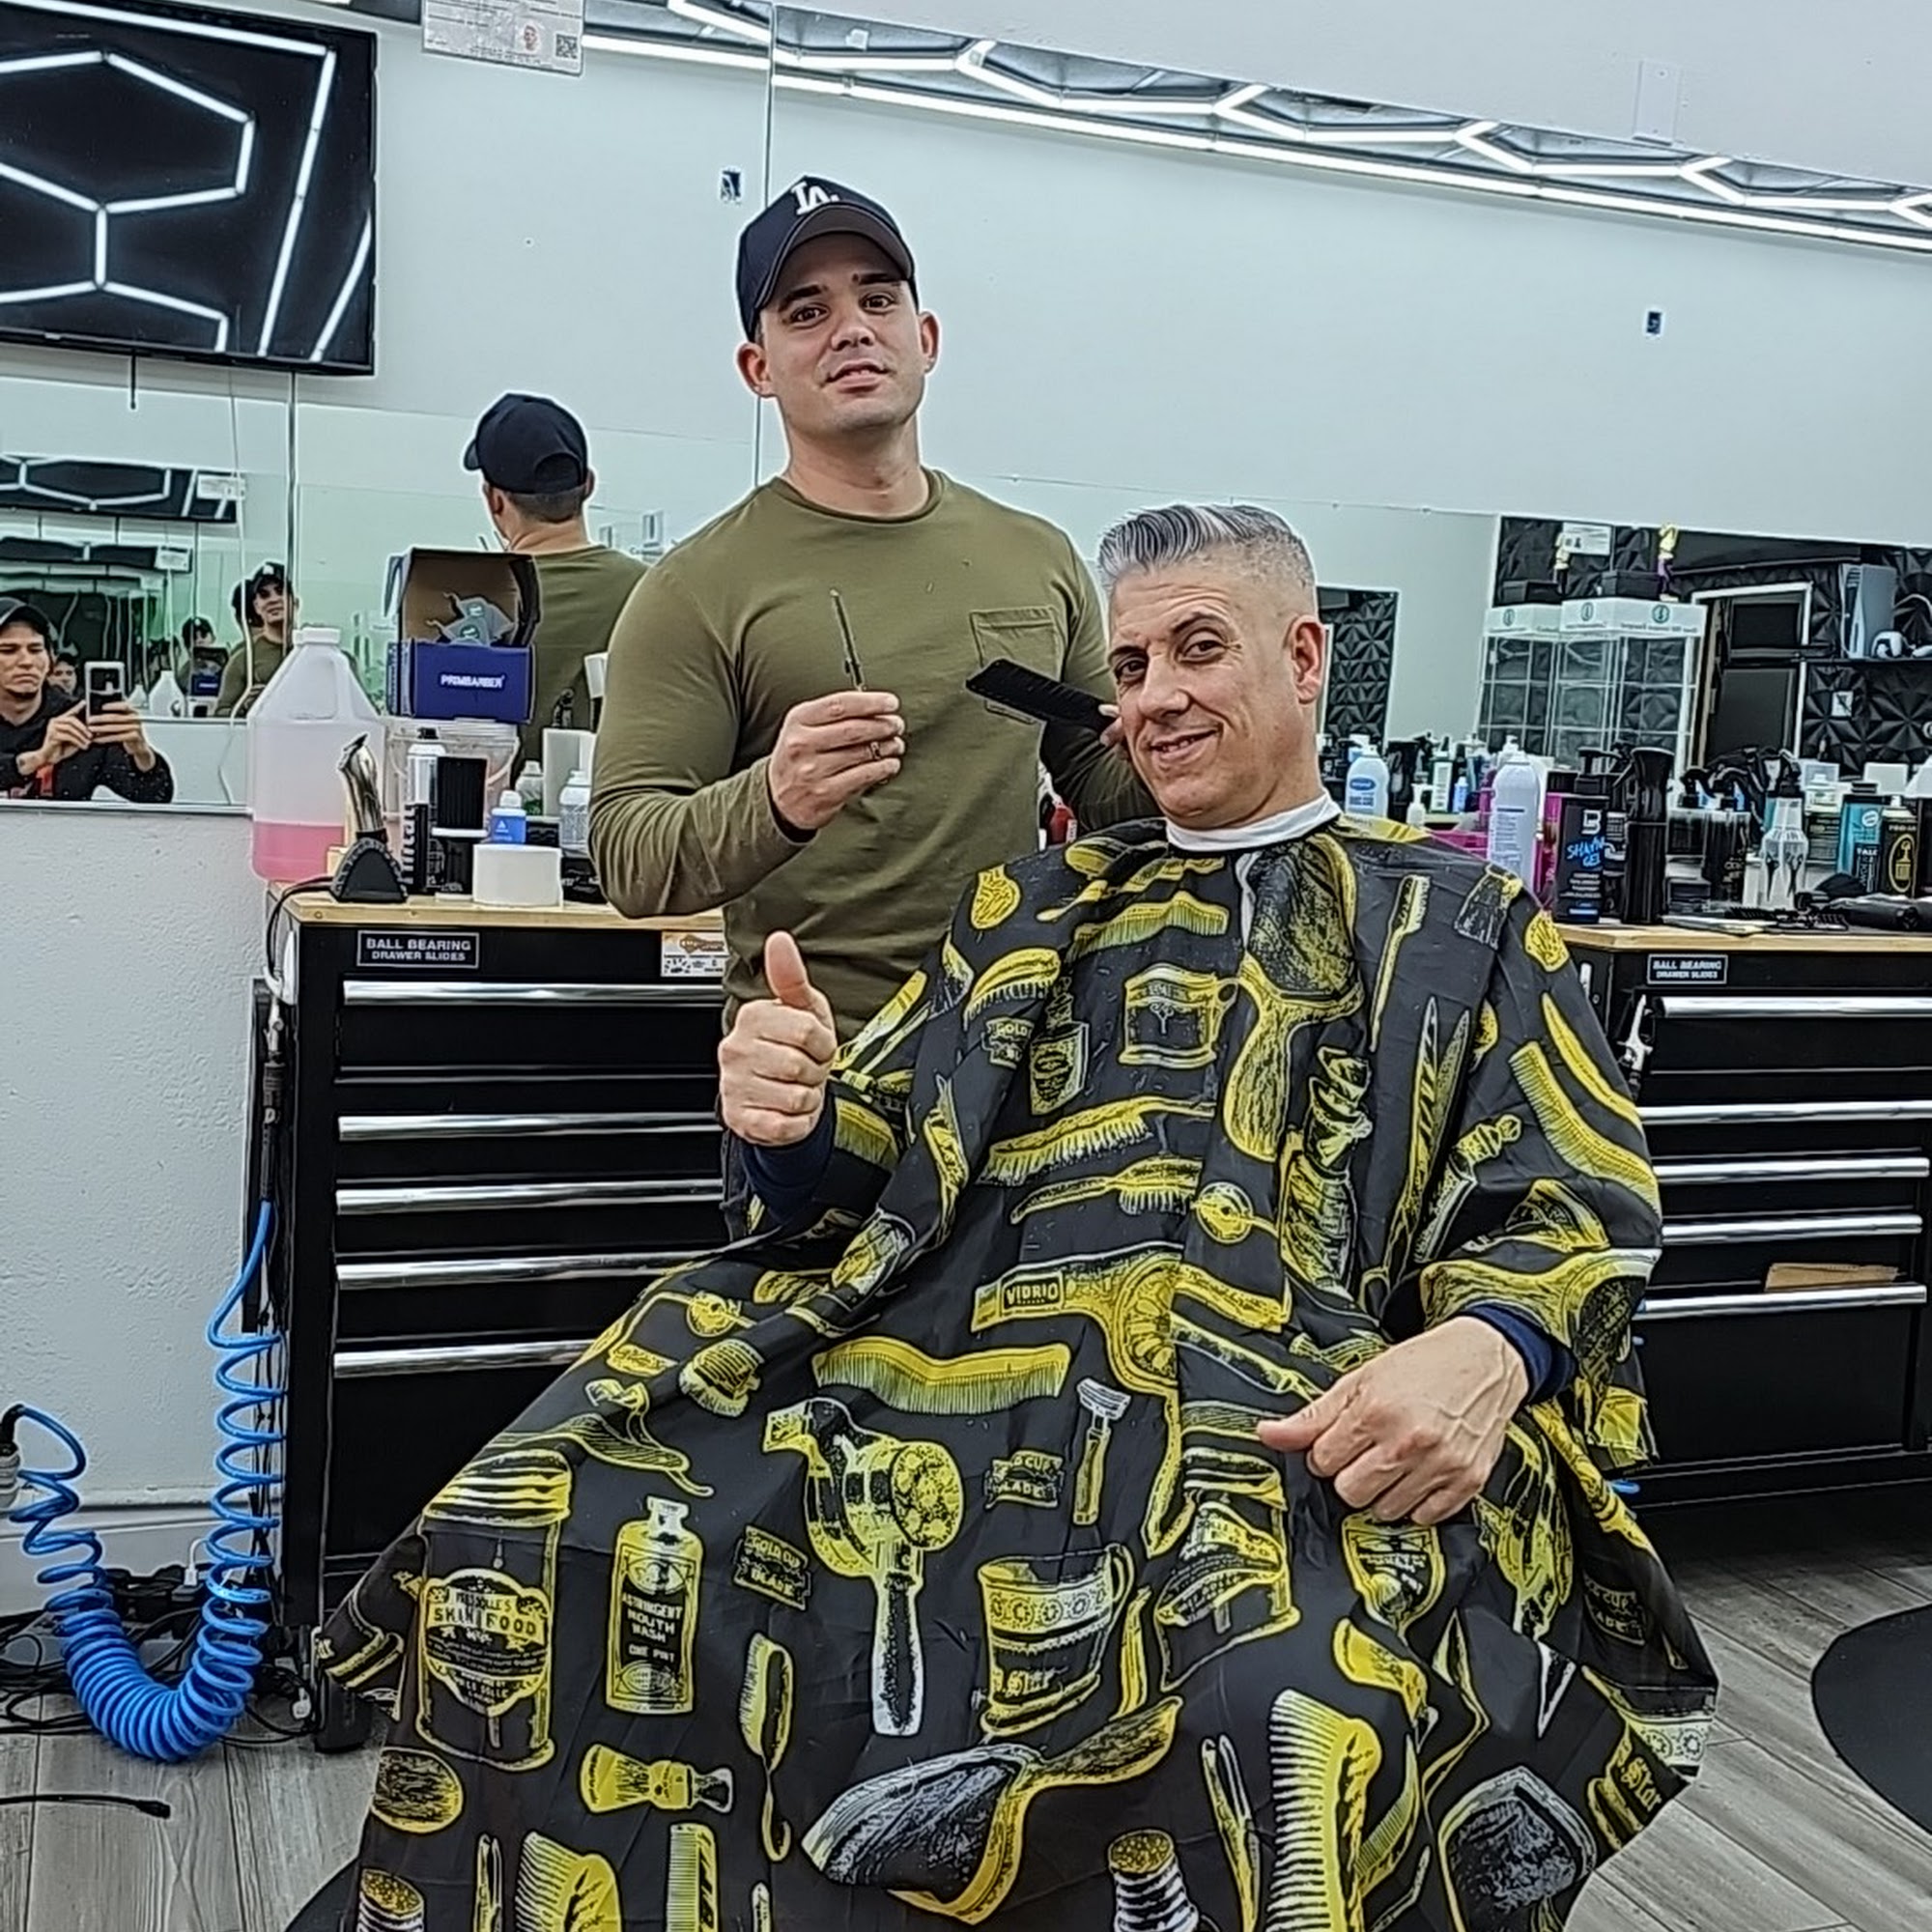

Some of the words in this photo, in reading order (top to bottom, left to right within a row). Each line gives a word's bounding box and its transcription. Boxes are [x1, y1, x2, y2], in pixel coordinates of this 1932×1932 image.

[791, 181, 839, 214] LA
[366, 938, 404, 949] BALL
[408, 939, 471, 951] BEARING
[372, 951, 422, 959] DRAWER
[425, 952, 466, 961] SLIDES
[1006, 1282, 1059, 1305] VIDRIO
[753, 1537, 782, 1560] GOLD
[486, 1612, 537, 1635] FOOD
[627, 1608, 675, 1635] MOUTH
[632, 1623, 667, 1643] WASH
